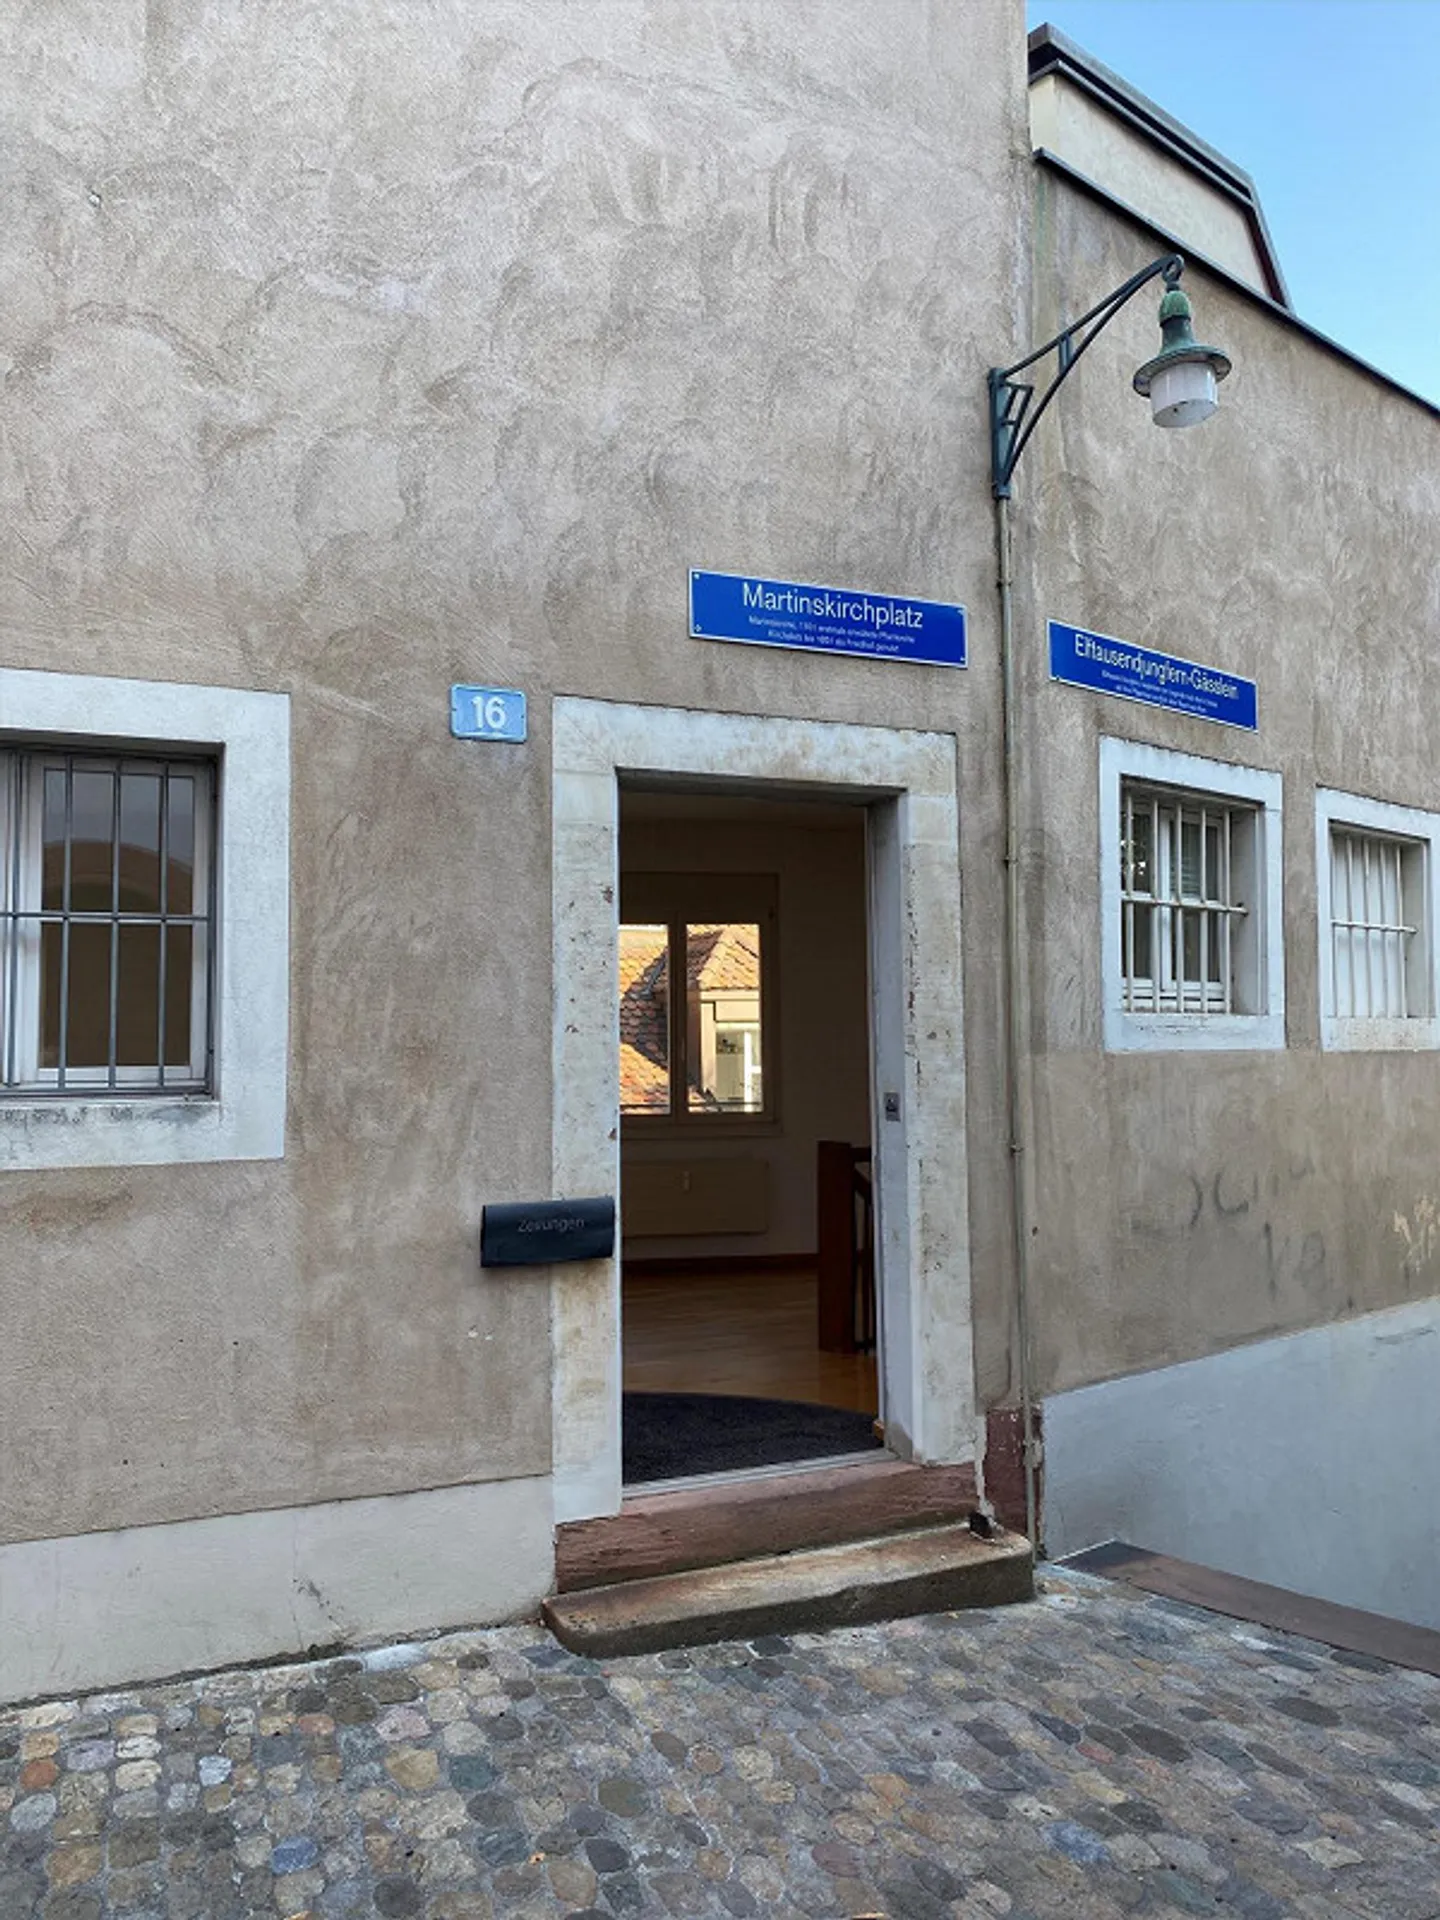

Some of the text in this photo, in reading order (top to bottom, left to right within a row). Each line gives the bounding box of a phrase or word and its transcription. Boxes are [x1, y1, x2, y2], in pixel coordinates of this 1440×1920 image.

[743, 582, 923, 629] Martinskirchplatz
[1074, 633, 1239, 699] Elftausendjungfern-Gässlein
[472, 696, 506, 729] 16
